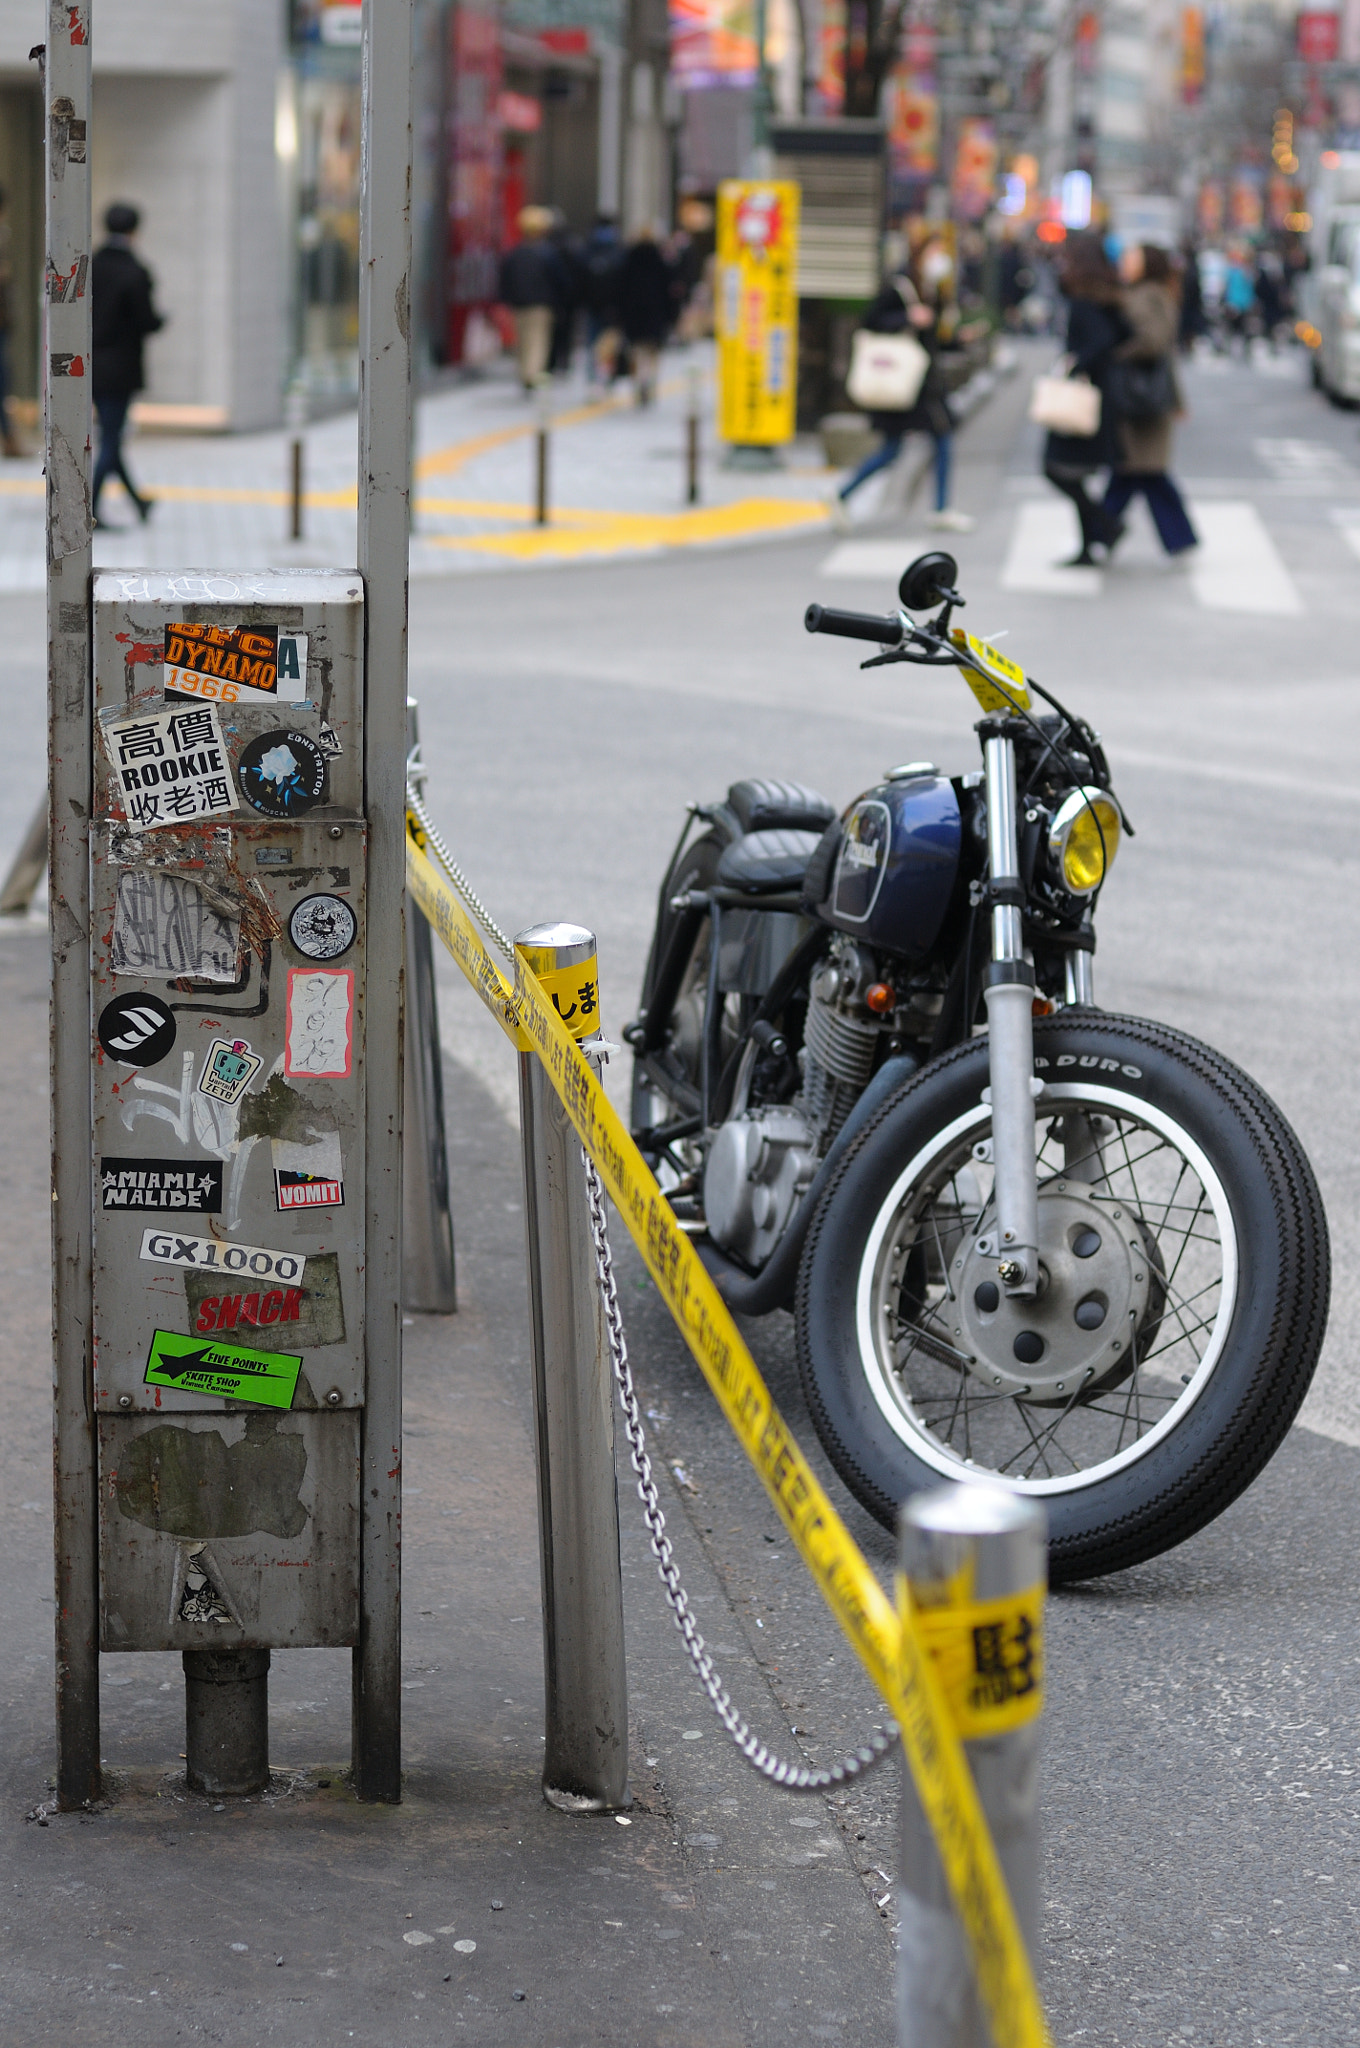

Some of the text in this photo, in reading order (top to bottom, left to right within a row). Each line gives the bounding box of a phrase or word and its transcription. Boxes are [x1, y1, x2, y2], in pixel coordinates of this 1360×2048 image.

[168, 623, 274, 658] BFC
[165, 636, 276, 690] DYNAMO
[167, 668, 241, 703] 1966
[113, 708, 218, 765] 高價
[121, 748, 224, 792] ROOKIE
[312, 751, 324, 796] TATTOO
[130, 776, 231, 826] 收老酒
[552, 979, 599, 1021] しま
[104, 1188, 202, 1208] NALIDE
[117, 1170, 196, 1190] MIAMI
[281, 1183, 338, 1205] VOMIT
[148, 1234, 298, 1280] GX1000
[197, 1288, 306, 1331] SNACK
[185, 1370, 241, 1389] SKATE SHOP
[207, 1352, 270, 1373] FIVE POINTS
